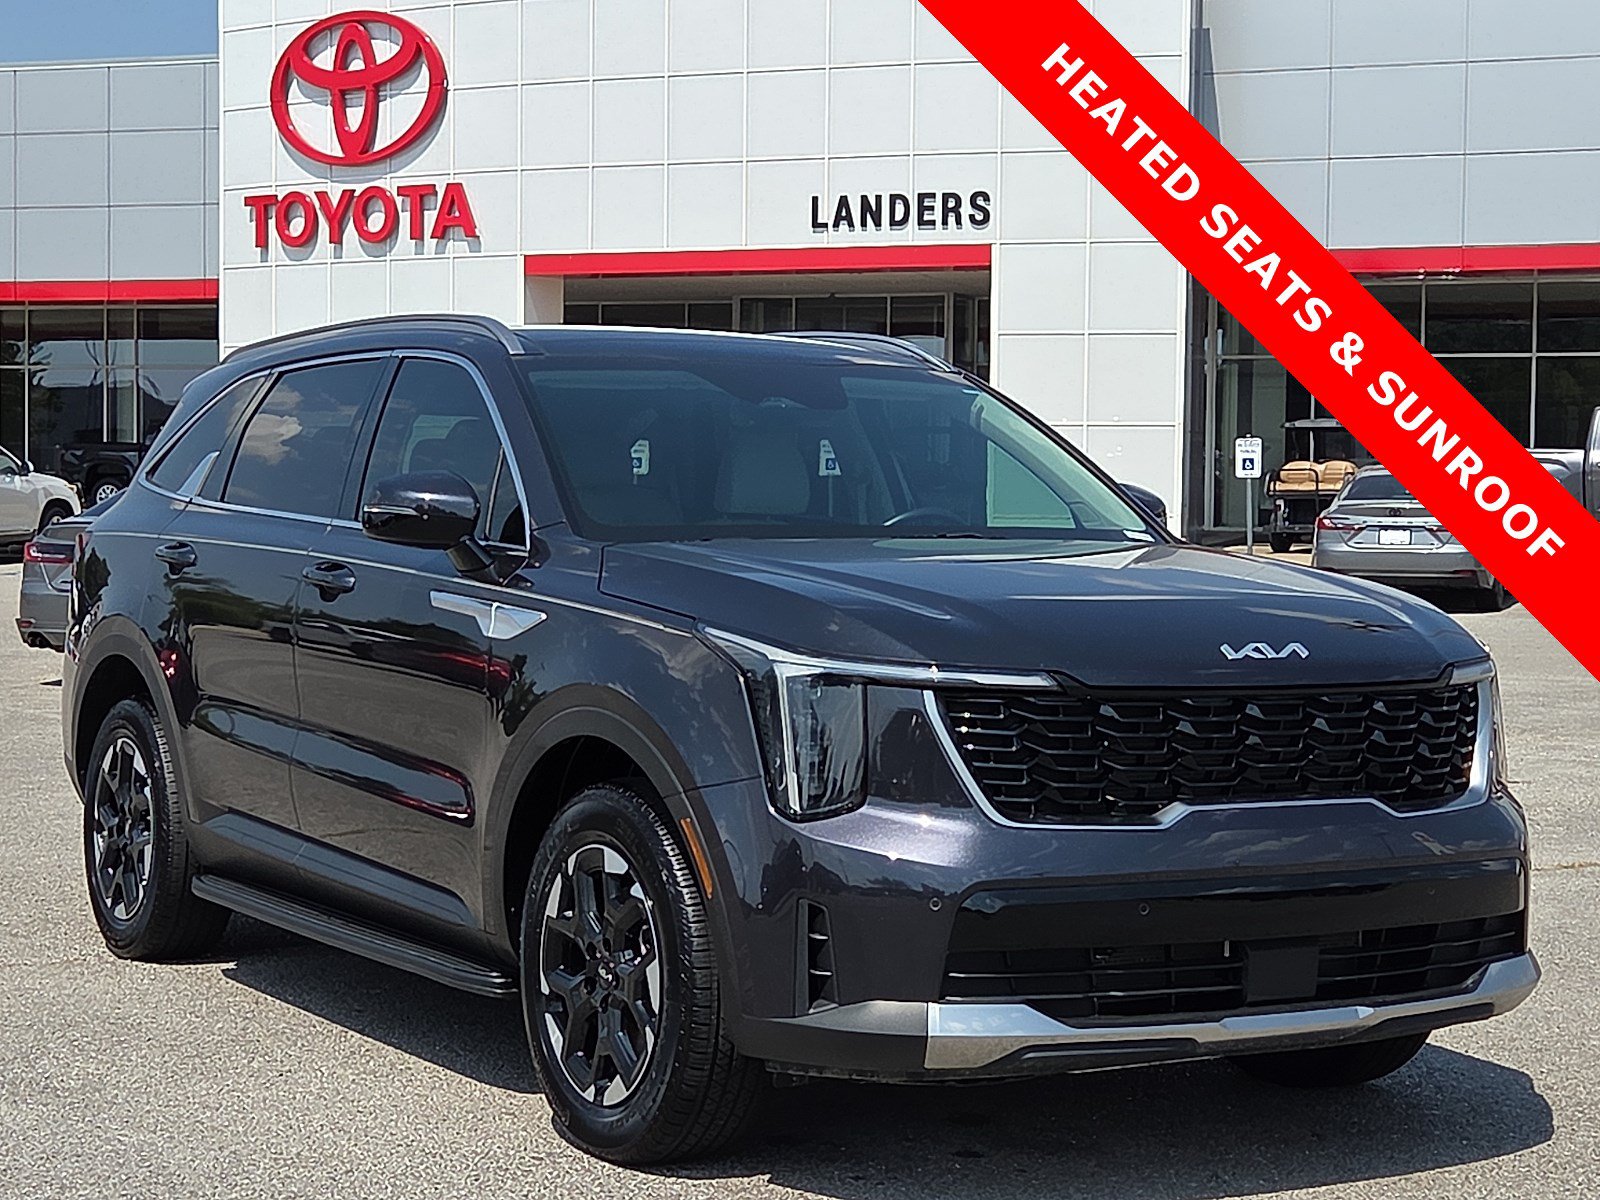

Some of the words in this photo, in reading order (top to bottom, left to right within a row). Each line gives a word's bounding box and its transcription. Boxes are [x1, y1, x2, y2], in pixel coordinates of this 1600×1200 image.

[244, 182, 480, 248] TOYOTA
[811, 191, 991, 232] LANDERS
[1220, 642, 1309, 660] KIA
